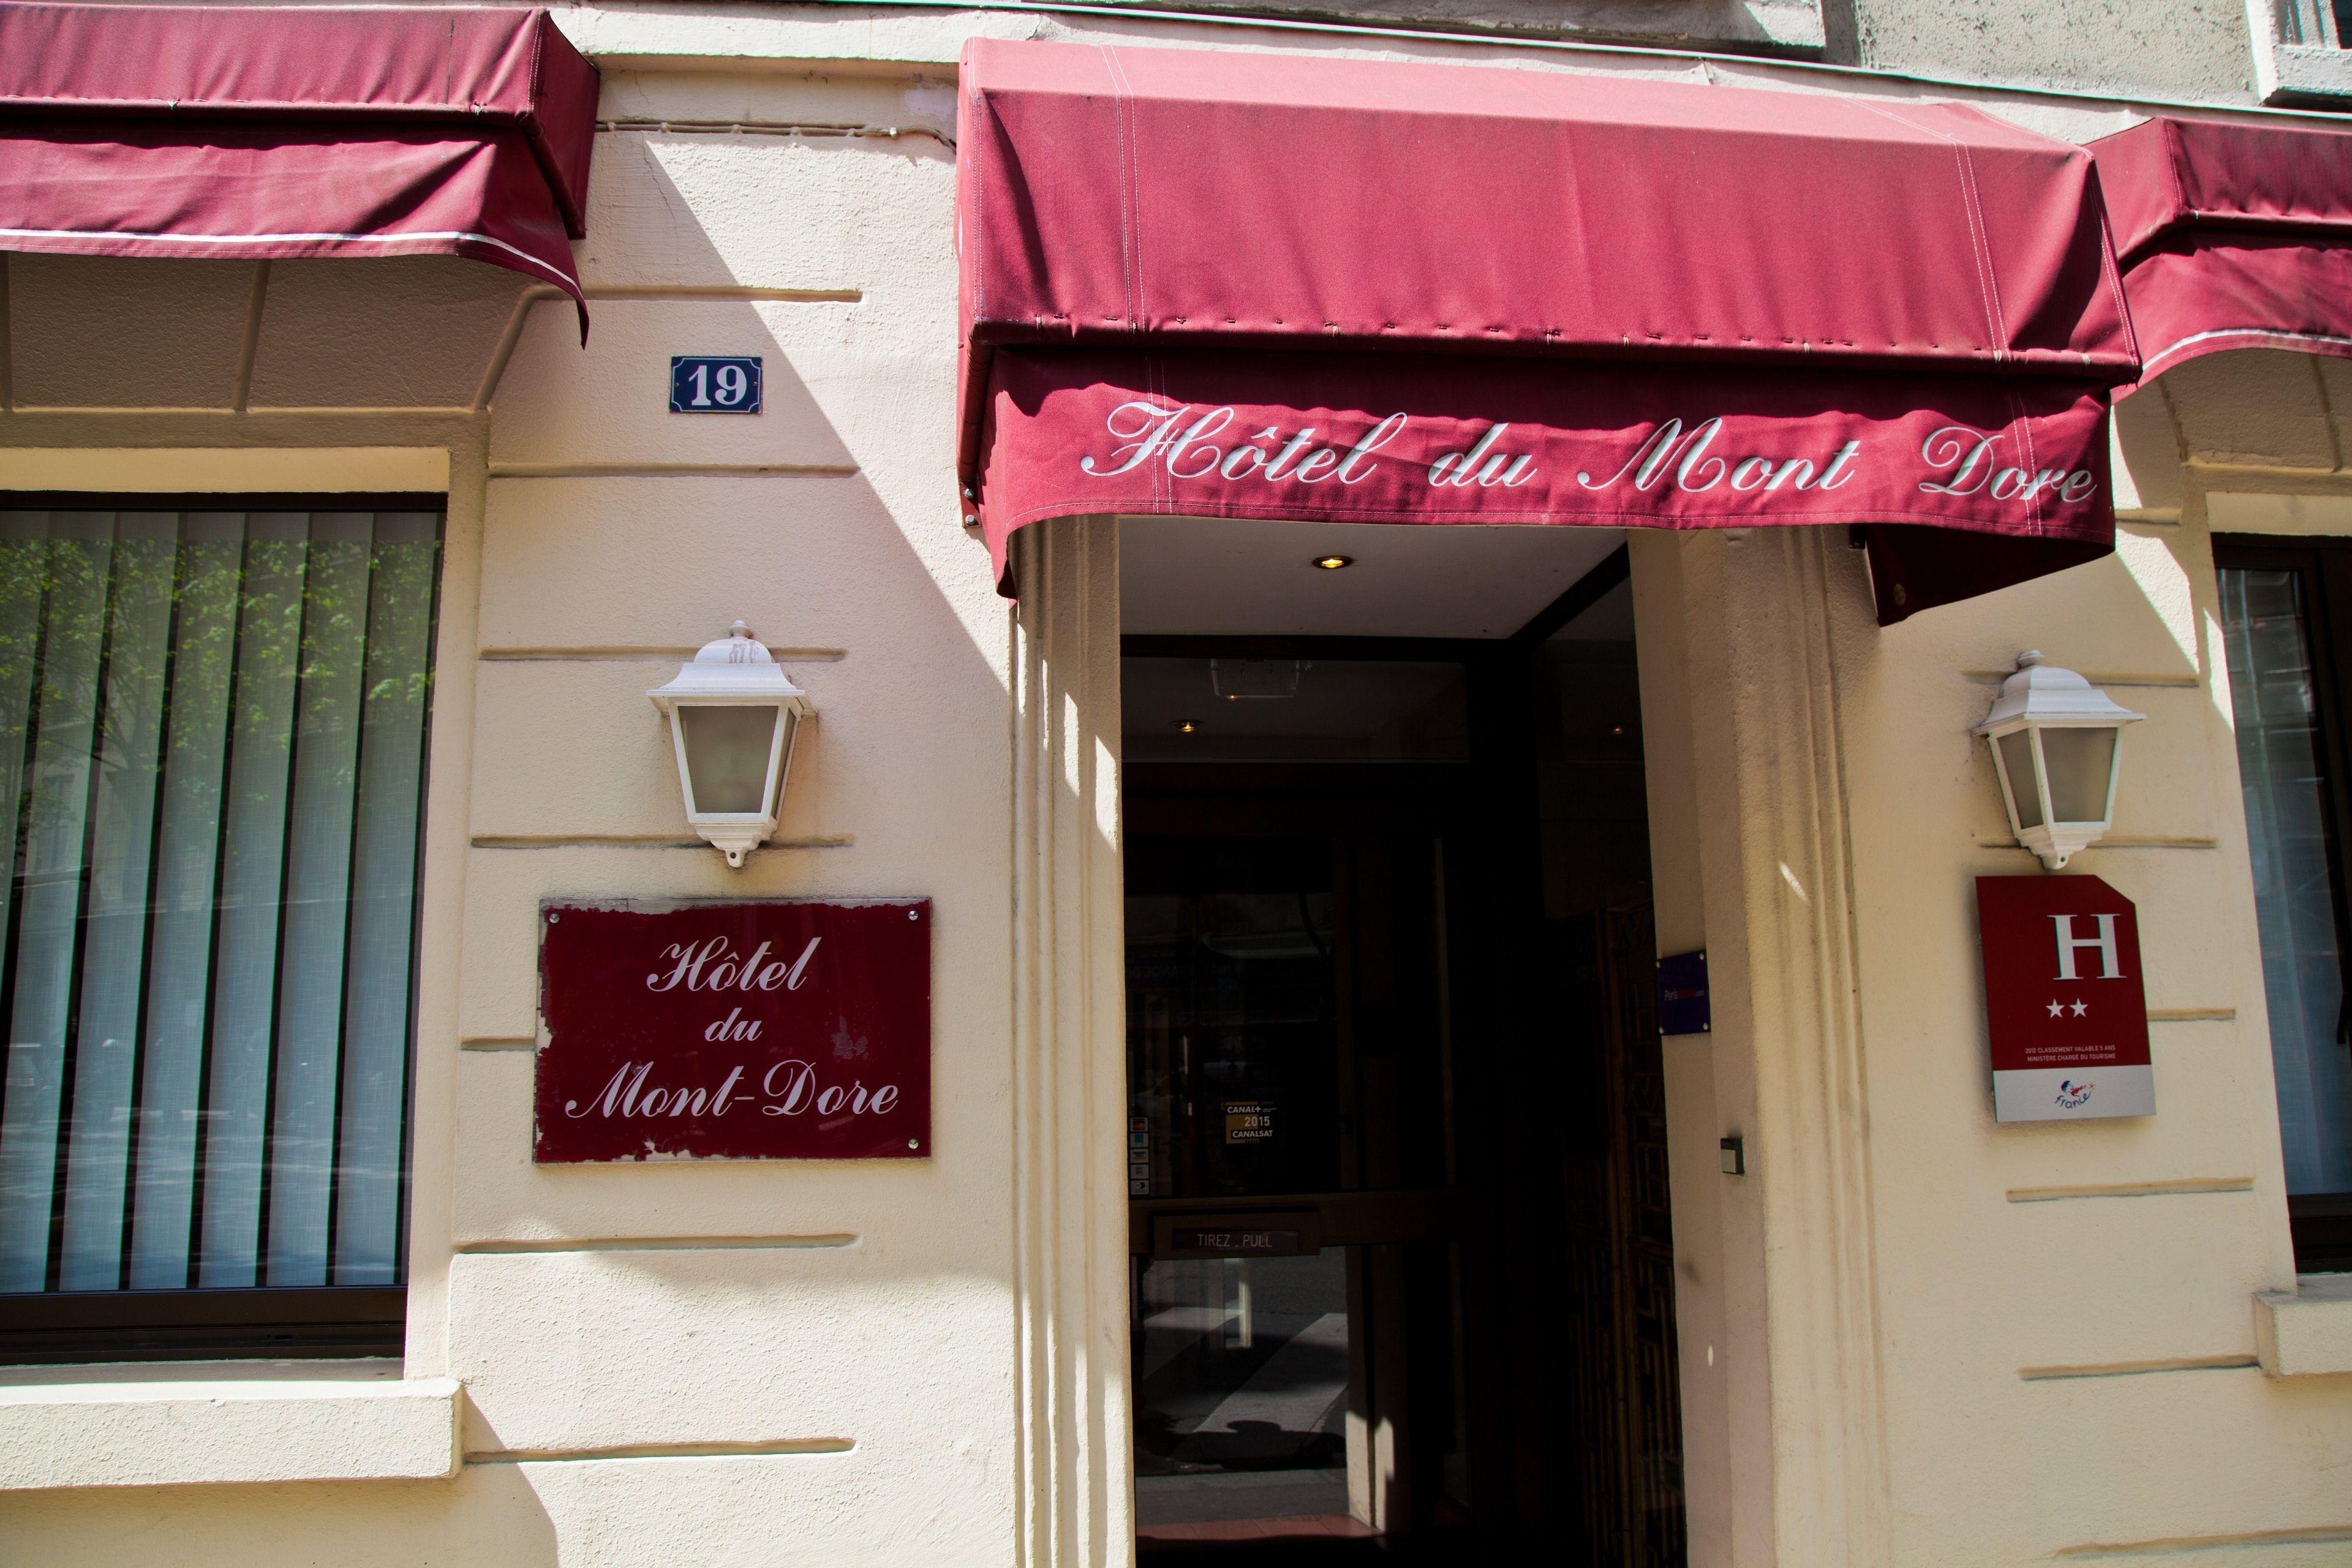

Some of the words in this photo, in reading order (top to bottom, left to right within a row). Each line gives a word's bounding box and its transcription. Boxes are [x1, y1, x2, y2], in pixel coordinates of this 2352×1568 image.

[688, 365, 747, 405] 19
[1081, 401, 1407, 485] Hôtel
[1428, 423, 1539, 488] du
[1577, 417, 1860, 494] Mont
[1918, 426, 2097, 503] Dore
[647, 936, 822, 992] Hôtel
[2047, 914, 2127, 979] H
[704, 1008, 762, 1041] du
[565, 1059, 899, 1118] Mont-Dore
[1245, 1116, 1270, 1126] 2015
[1197, 1234, 1230, 1247] TIREZ
[1243, 1234, 1272, 1248] PULL
